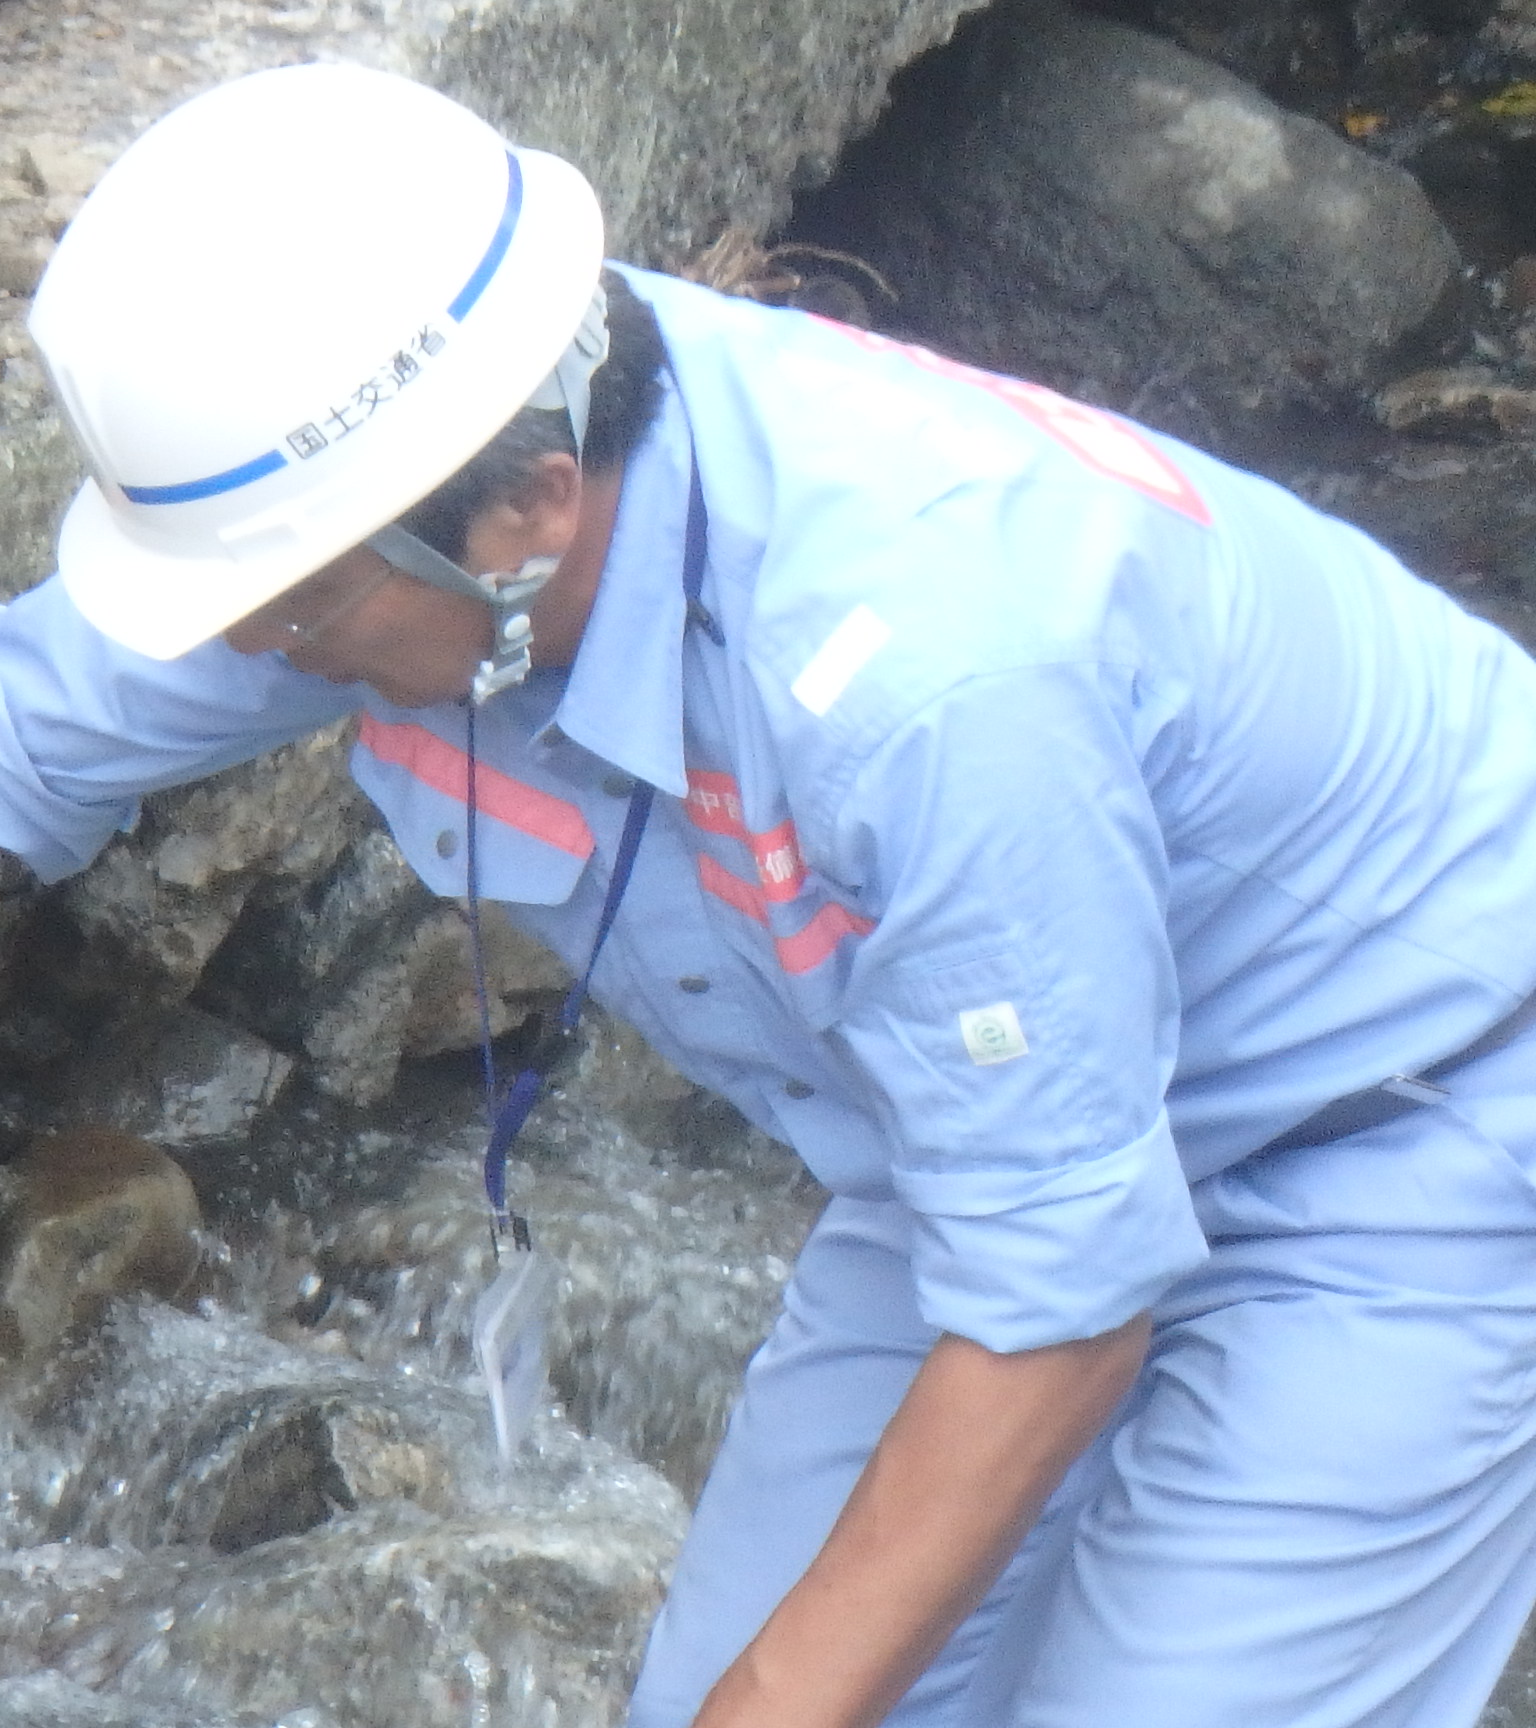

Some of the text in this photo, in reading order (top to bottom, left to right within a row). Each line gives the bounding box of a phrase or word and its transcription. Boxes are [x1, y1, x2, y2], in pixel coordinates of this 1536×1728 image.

[285, 322, 447, 460] 国土交通省
